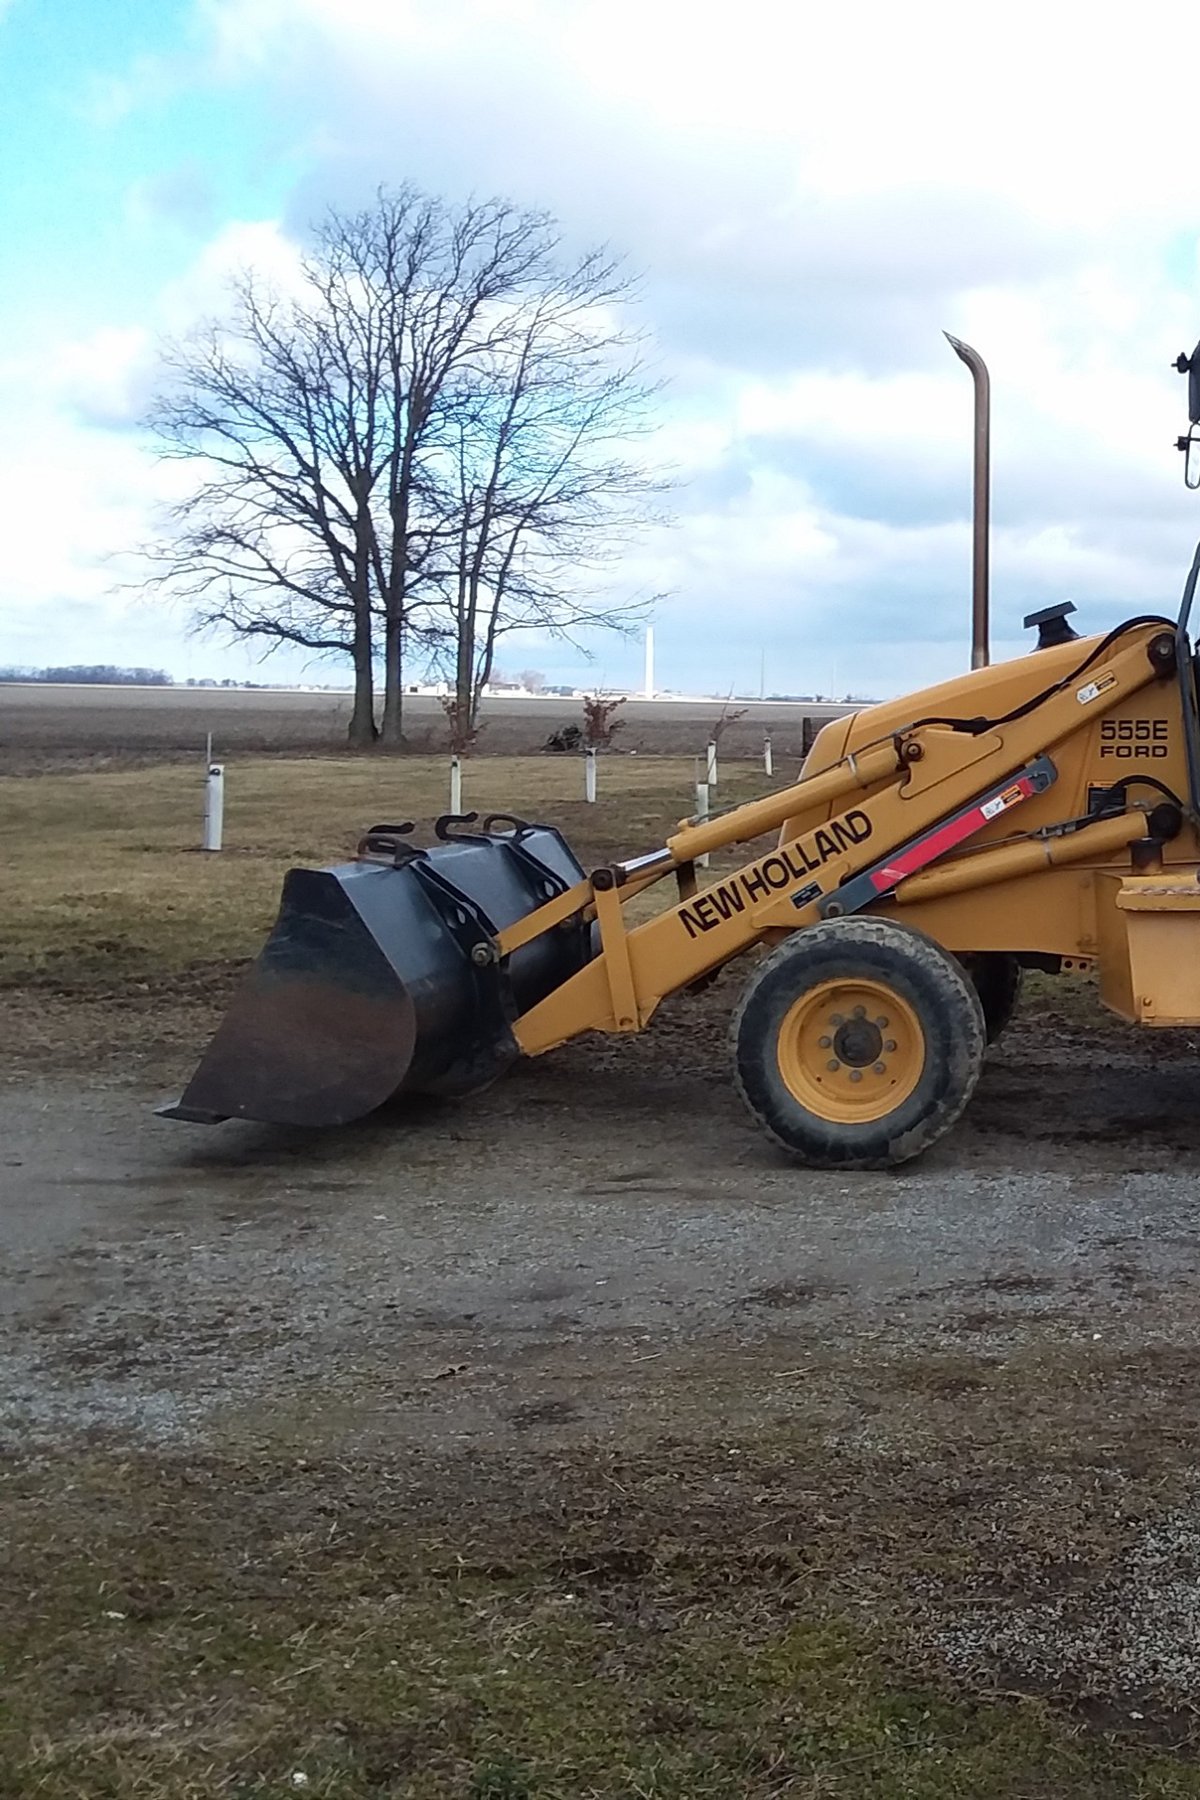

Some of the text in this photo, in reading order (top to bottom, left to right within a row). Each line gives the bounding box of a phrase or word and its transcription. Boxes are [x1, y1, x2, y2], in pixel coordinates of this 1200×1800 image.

[1100, 720, 1168, 740] 555E
[1100, 745, 1168, 758] FORD
[677, 810, 873, 939] NEW HOLLAND
